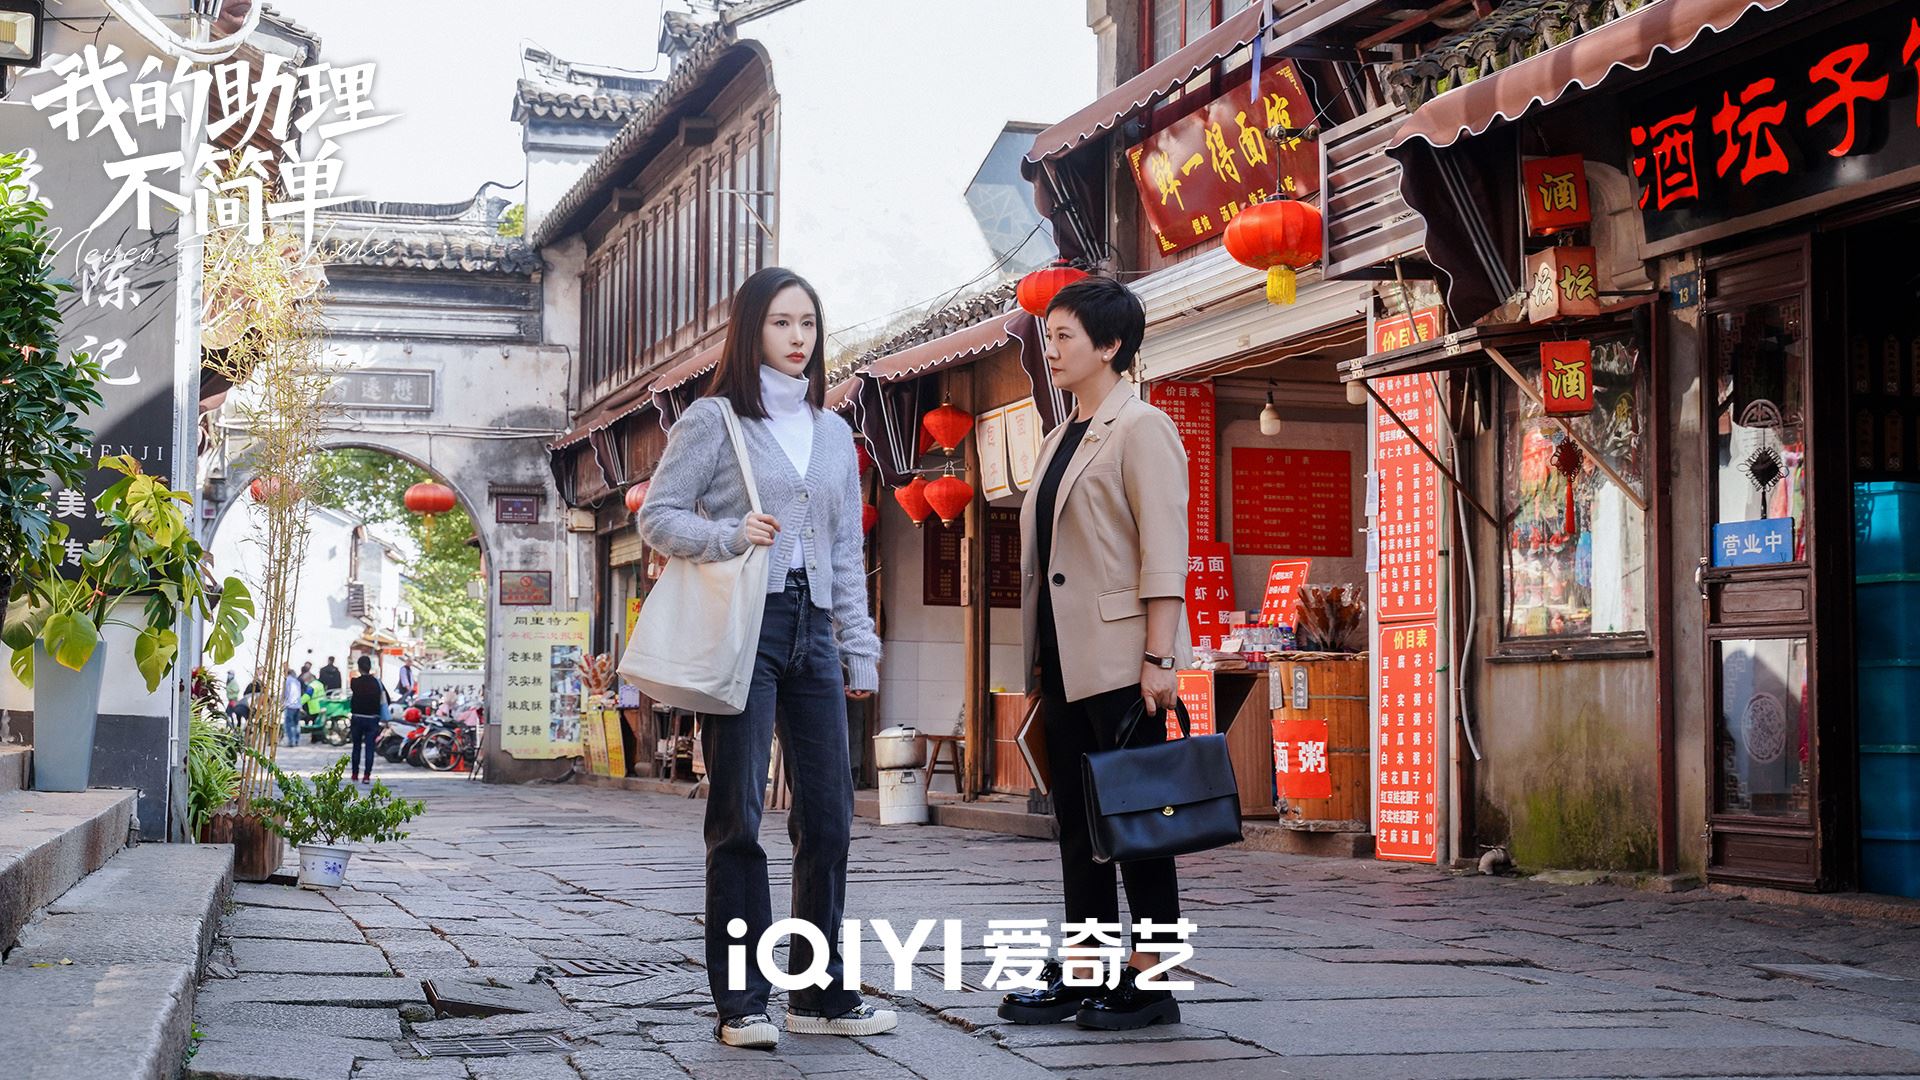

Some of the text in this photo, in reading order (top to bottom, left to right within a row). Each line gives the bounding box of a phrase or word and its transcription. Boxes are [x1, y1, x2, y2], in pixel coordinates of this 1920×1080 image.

[1538, 172, 1578, 211] 酒
[1558, 264, 1598, 300] 坛
[1679, 287, 1689, 304] 13
[1548, 359, 1586, 400] 酒
[1165, 386, 1200, 397] 价目表
[1722, 530, 1782, 556] 营业中
[1188, 556, 1224, 572] 汤面
[513, 616, 580, 626] 同里特产
[1393, 629, 1428, 650] 价目表
[508, 651, 543, 663] 老姜糖
[1428, 652, 1433, 664] 5
[1428, 672, 1433, 684] 2
[1427, 752, 1432, 764] 3
[1425, 793, 1432, 805] 10
[1425, 813, 1432, 825] 10
[1425, 833, 1432, 845] 10
